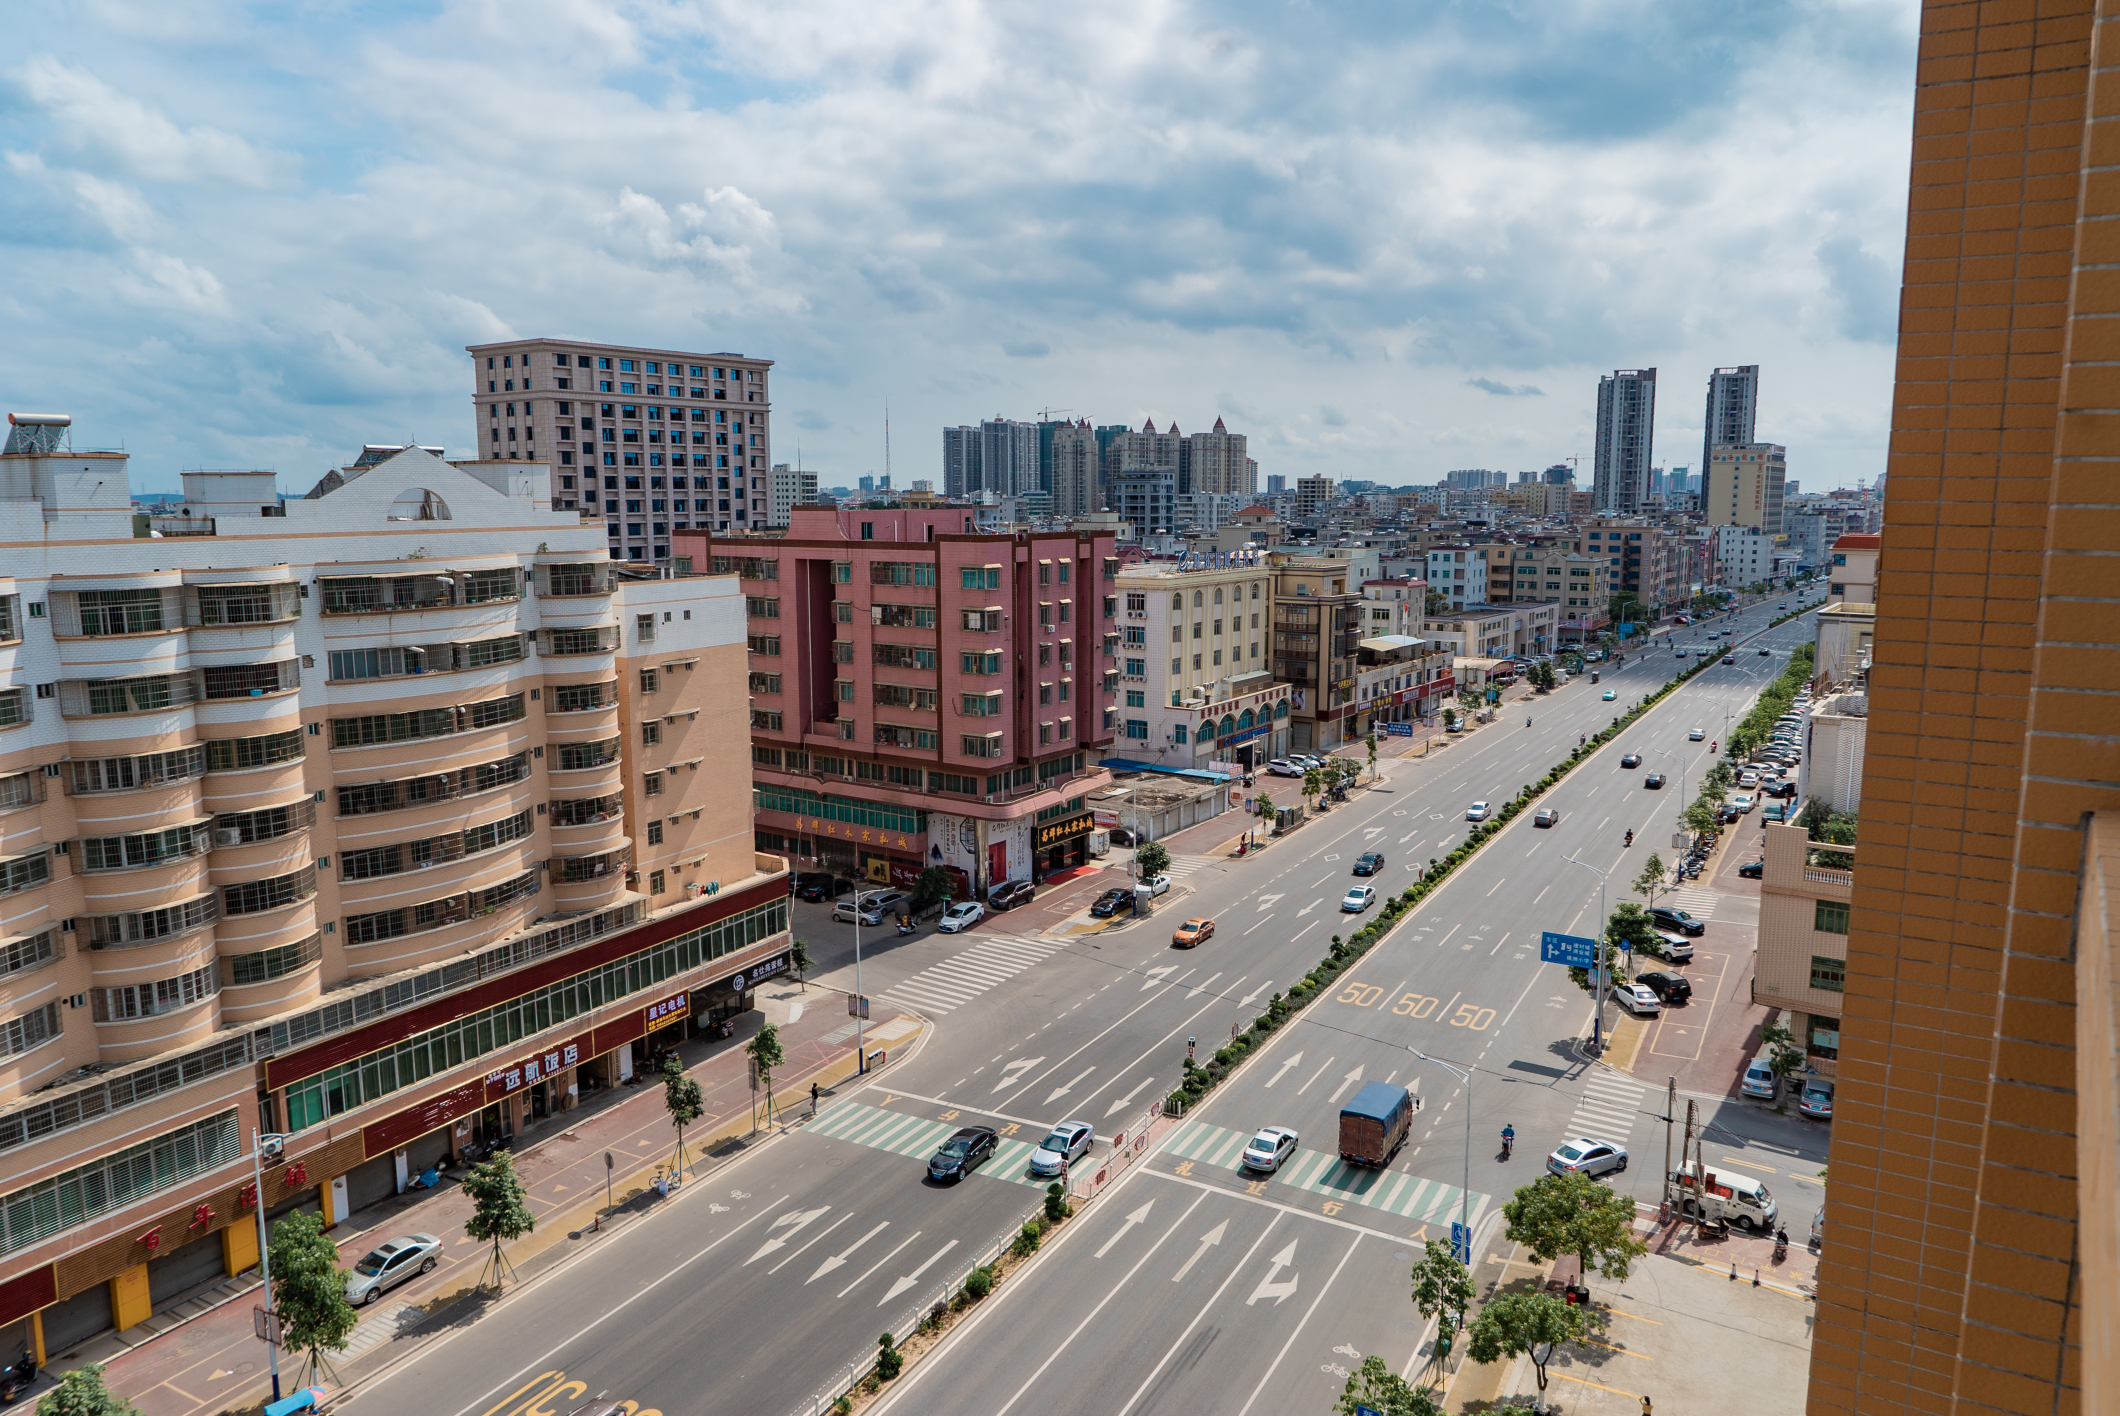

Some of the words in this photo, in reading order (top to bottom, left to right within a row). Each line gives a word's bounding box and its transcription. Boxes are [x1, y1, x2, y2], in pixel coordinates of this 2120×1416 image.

[1336, 981, 1384, 1007] 50
[1392, 992, 1440, 1019] 50
[1449, 1003, 1497, 1031] 50
[505, 1044, 578, 1091] 远航饭店
